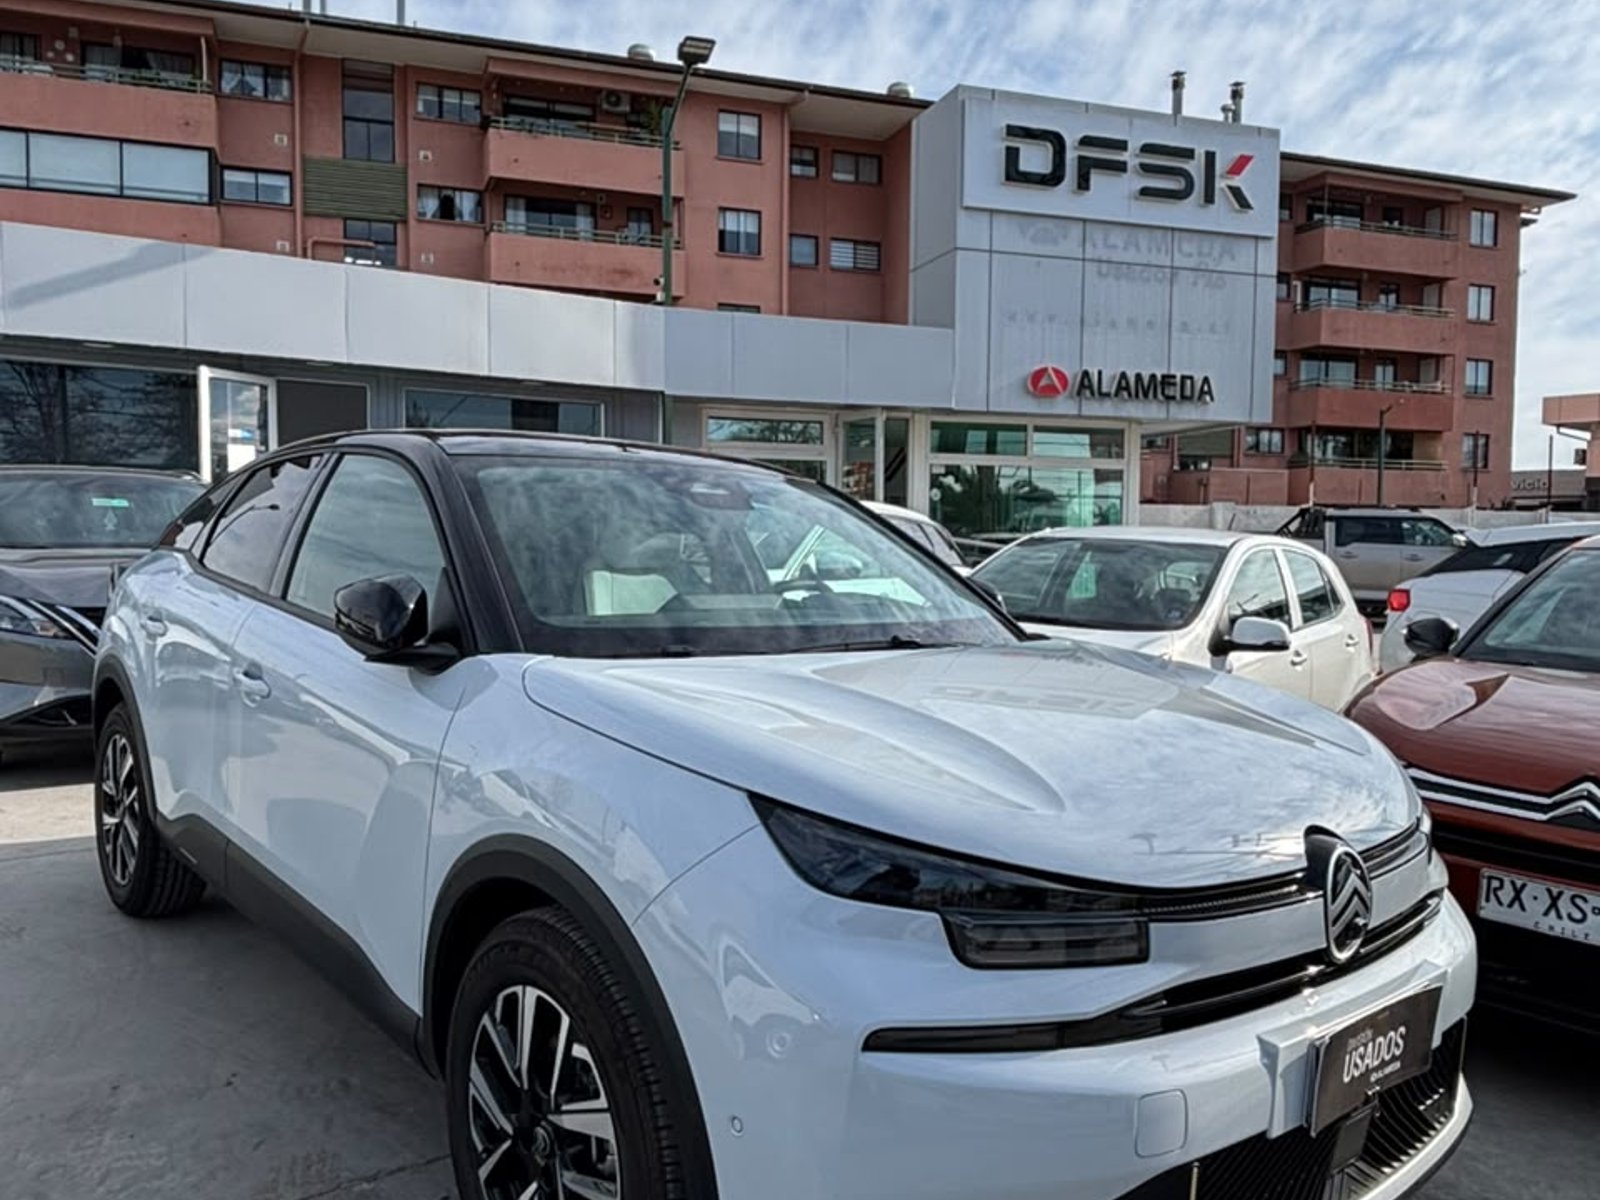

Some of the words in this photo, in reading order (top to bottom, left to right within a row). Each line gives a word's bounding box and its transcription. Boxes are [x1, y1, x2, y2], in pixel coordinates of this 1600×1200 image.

[1003, 123, 1254, 211] DFSK
[1075, 369, 1214, 402] ALAMEDA
[1343, 1026, 1406, 1084] USADOS
